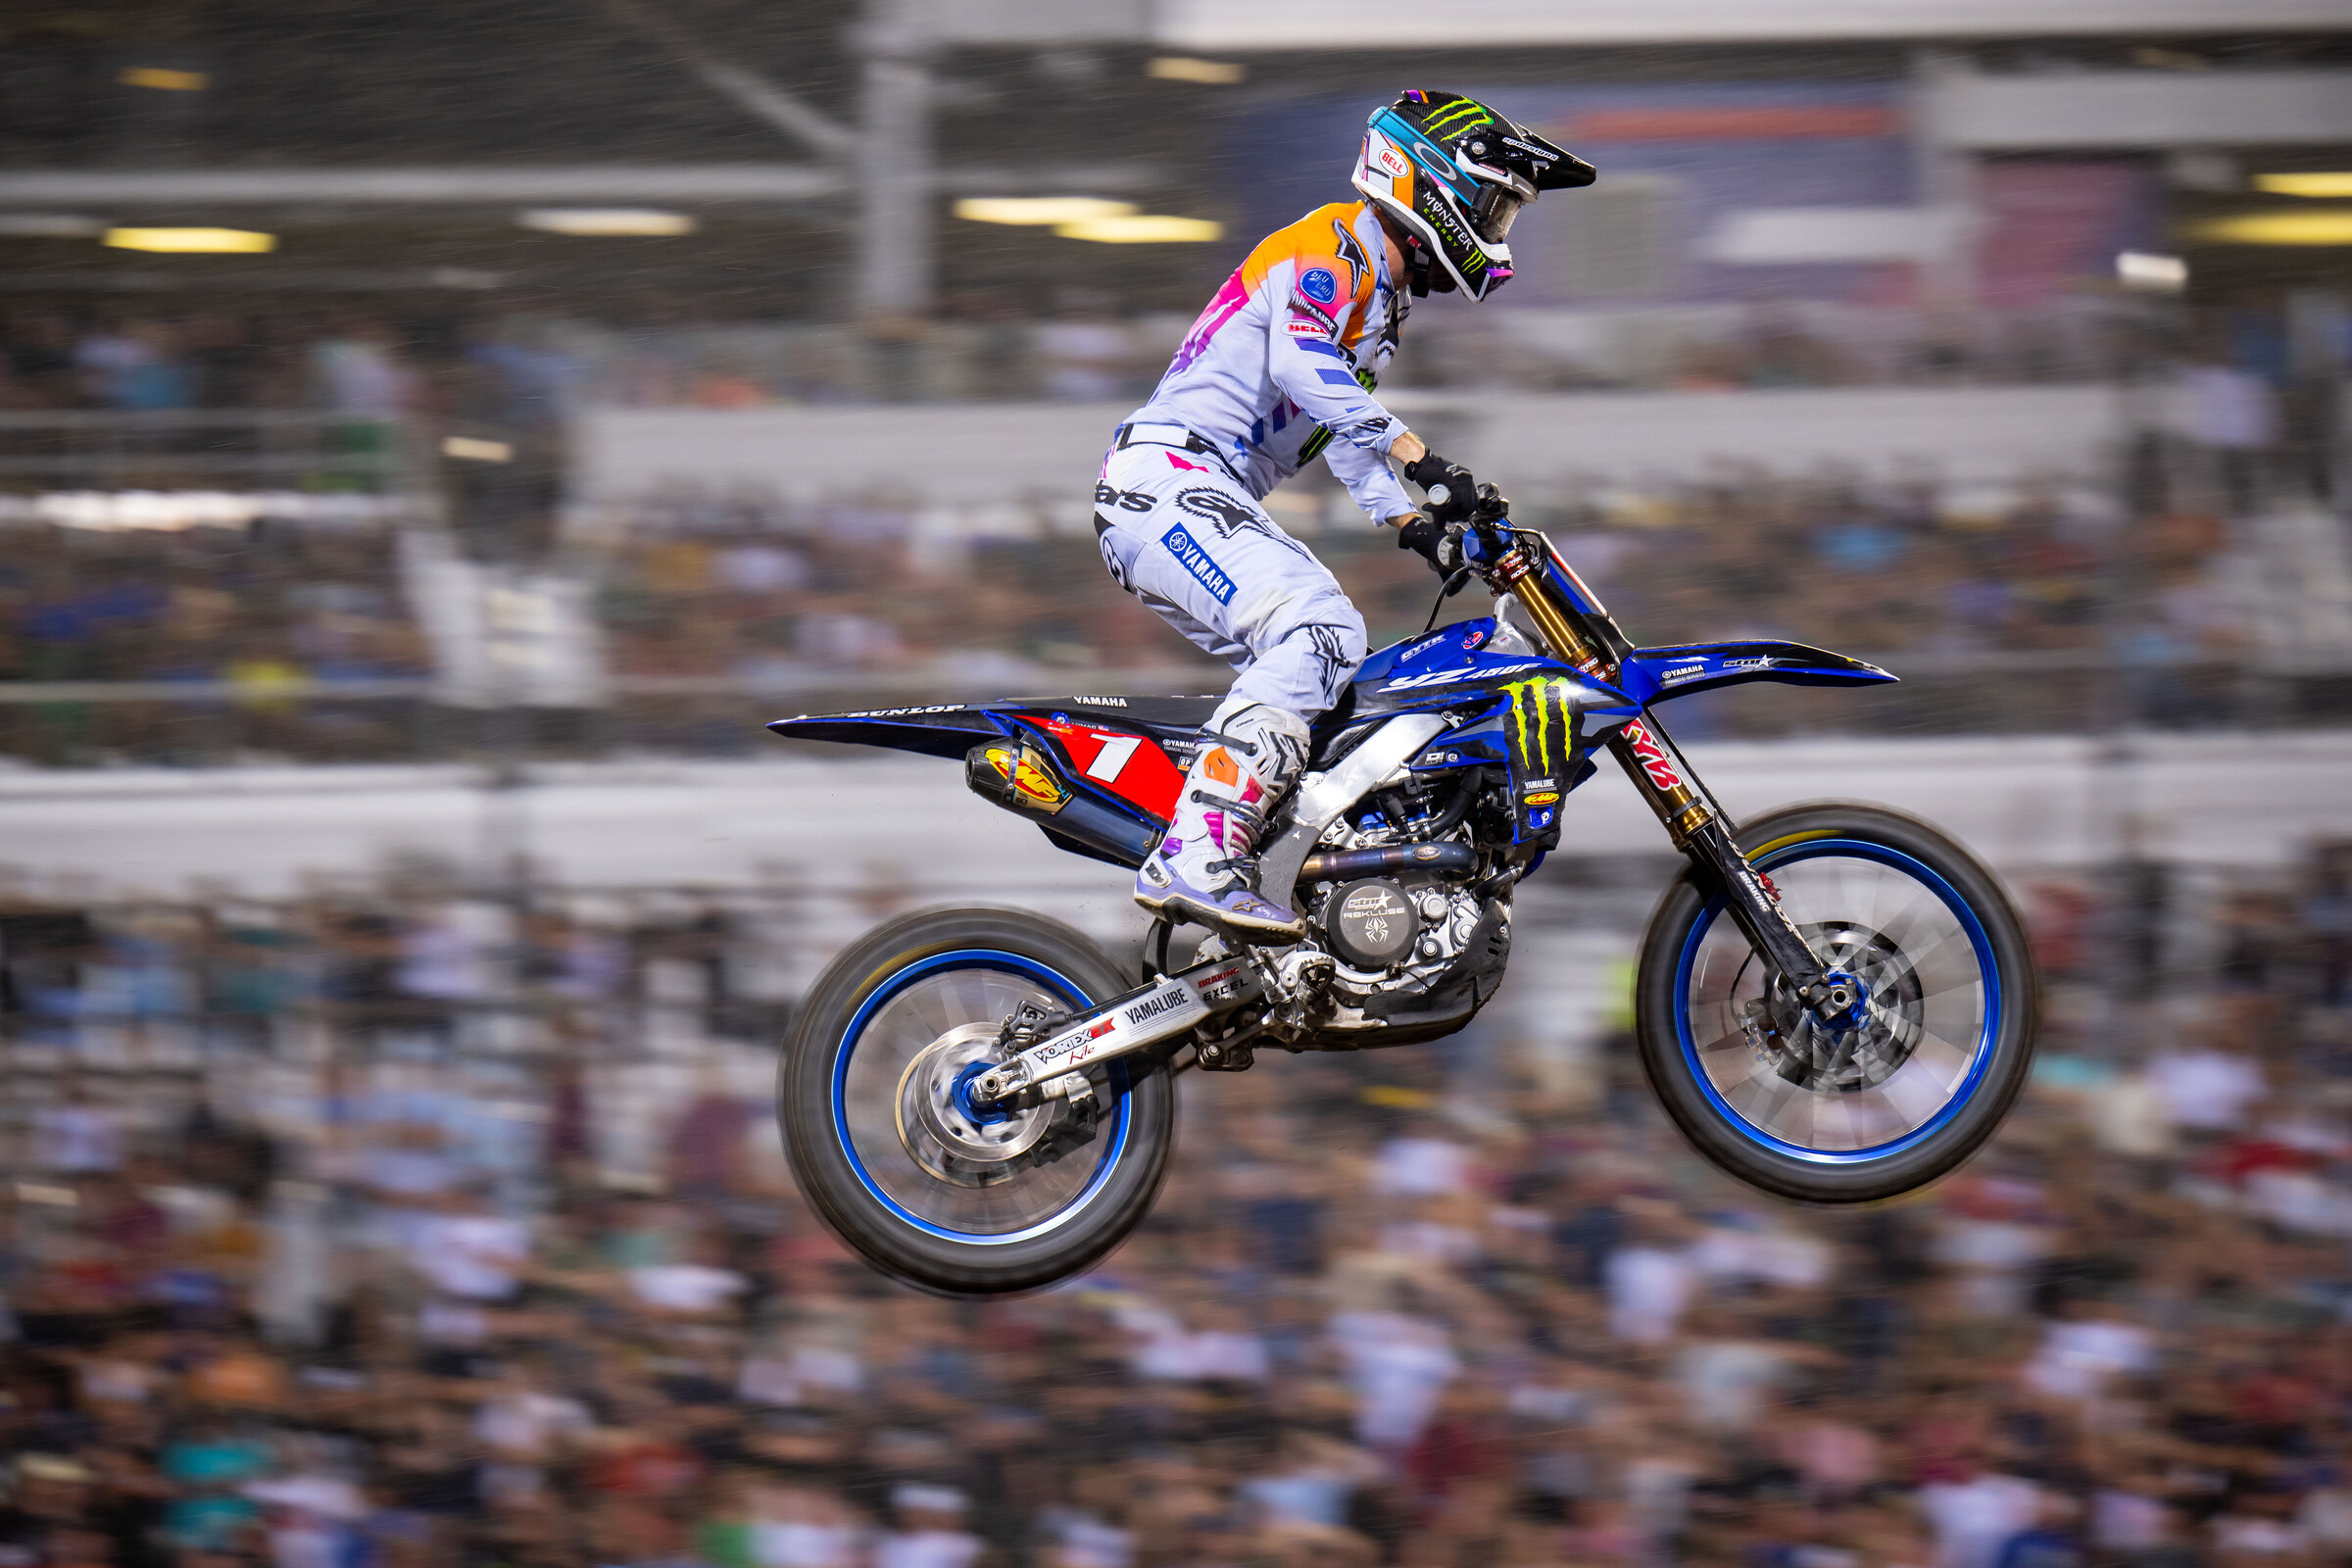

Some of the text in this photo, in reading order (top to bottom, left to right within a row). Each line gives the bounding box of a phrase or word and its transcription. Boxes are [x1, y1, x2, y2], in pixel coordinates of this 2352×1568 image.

[1381, 151, 1402, 174] BELL
[1423, 191, 1473, 251] MONSTER
[1423, 207, 1458, 248] ENERGY
[1182, 543, 1231, 601] YAMAHA
[1400, 635, 1446, 662] GYTR
[1671, 664, 1704, 677] YAMAHA
[848, 704, 965, 717] DUNLOP
[1073, 696, 1127, 708] YAMAHA
[1170, 739, 1196, 749] YAMAH
[1620, 716, 1682, 791] KYB
[1085, 733, 1144, 784] 1
[1524, 779, 1555, 790] YAMALUBE
[1737, 870, 1772, 912] BRAKING
[1344, 906, 1405, 919] REKLUSE
[1198, 966, 1240, 989] BRAKING
[1202, 978, 1250, 1002] EXCEL
[1125, 988, 1189, 1025] YAMALUBE
[1034, 1029, 1096, 1064] VORTEX
[1069, 1045, 1096, 1065] Kite
